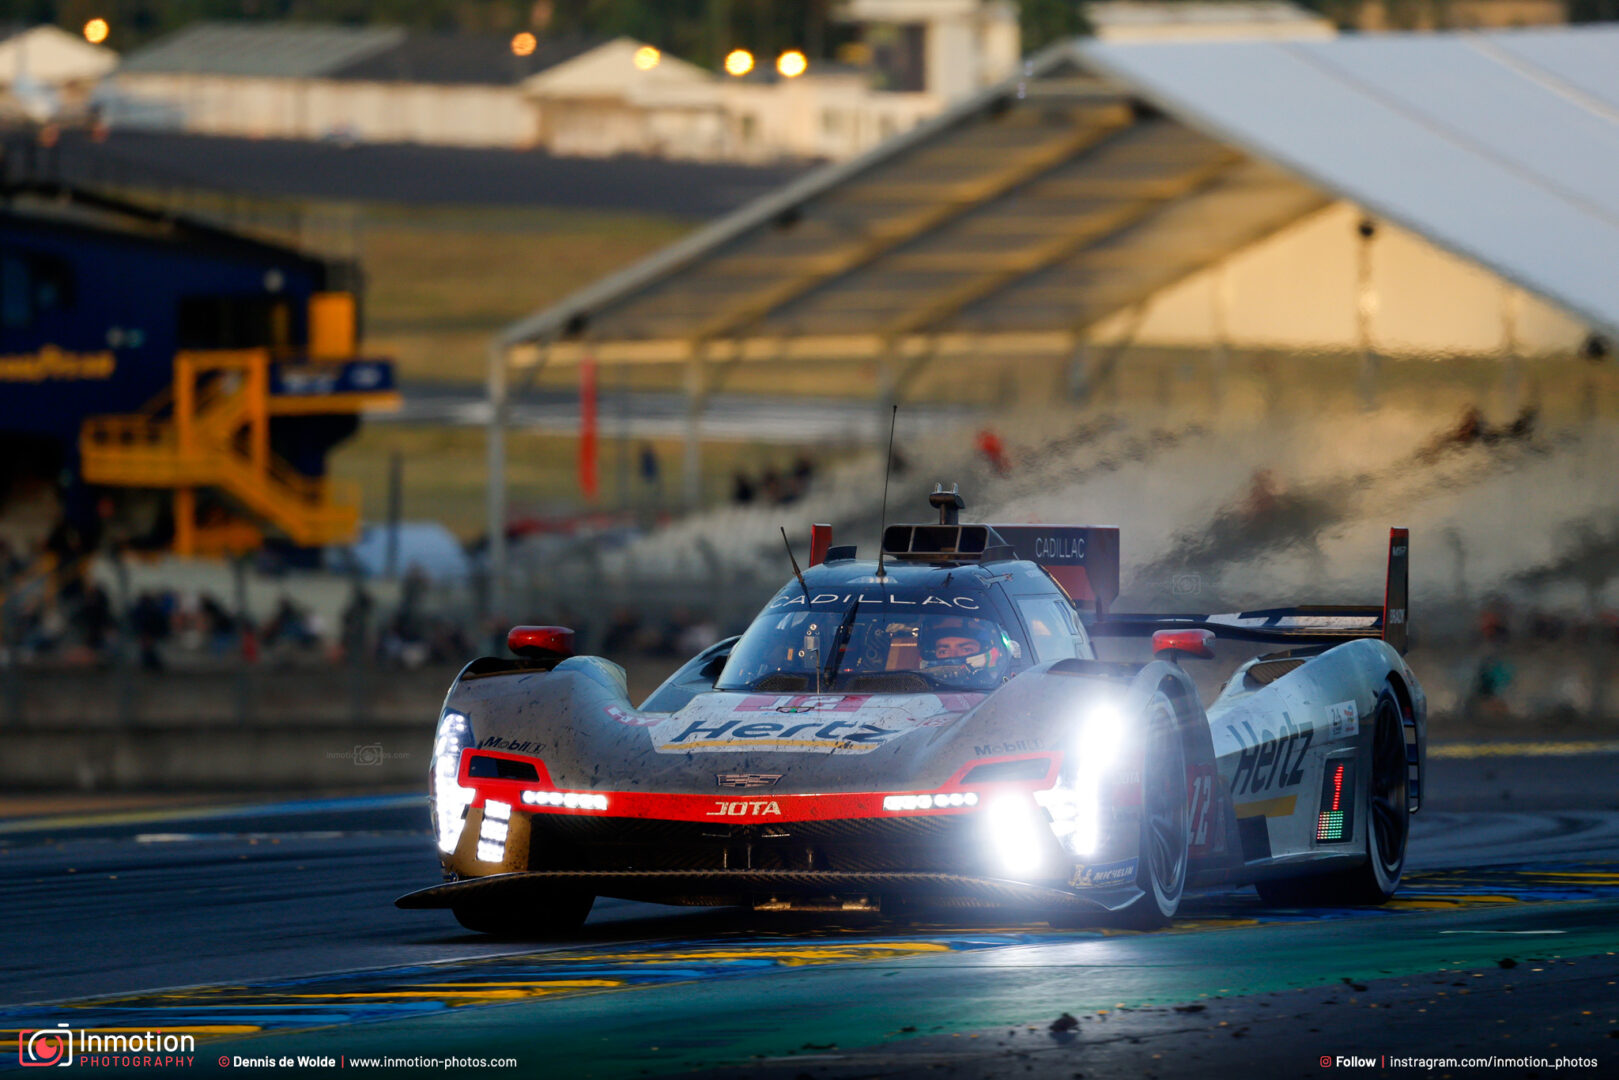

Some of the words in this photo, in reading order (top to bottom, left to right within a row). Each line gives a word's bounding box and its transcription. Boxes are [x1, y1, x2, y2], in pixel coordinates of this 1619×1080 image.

[1035, 537, 1085, 558] CADILLAC
[769, 594, 980, 610] CADILLAC
[670, 720, 900, 743] Hertz
[1227, 711, 1314, 796] Hertz
[706, 801, 781, 816] JOTA
[1186, 775, 1212, 846] 12
